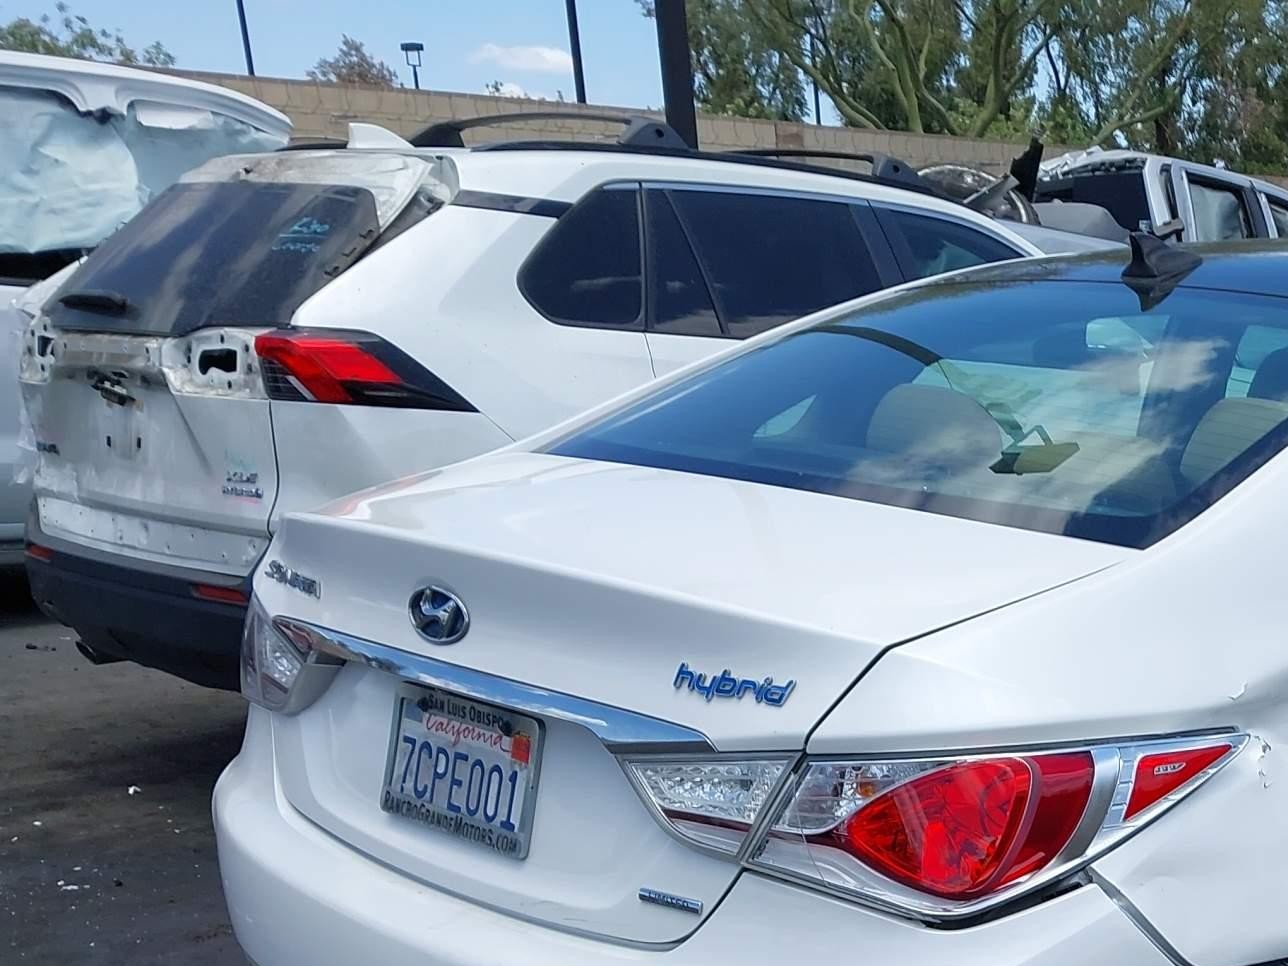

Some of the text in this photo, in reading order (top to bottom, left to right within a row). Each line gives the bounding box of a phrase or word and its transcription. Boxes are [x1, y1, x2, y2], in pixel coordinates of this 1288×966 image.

[673, 661, 797, 708] hybrid
[428, 694, 445, 712] SAN
[447, 699, 467, 719] LUIS
[426, 713, 512, 753] California
[401, 735, 518, 833] 7CPE001
